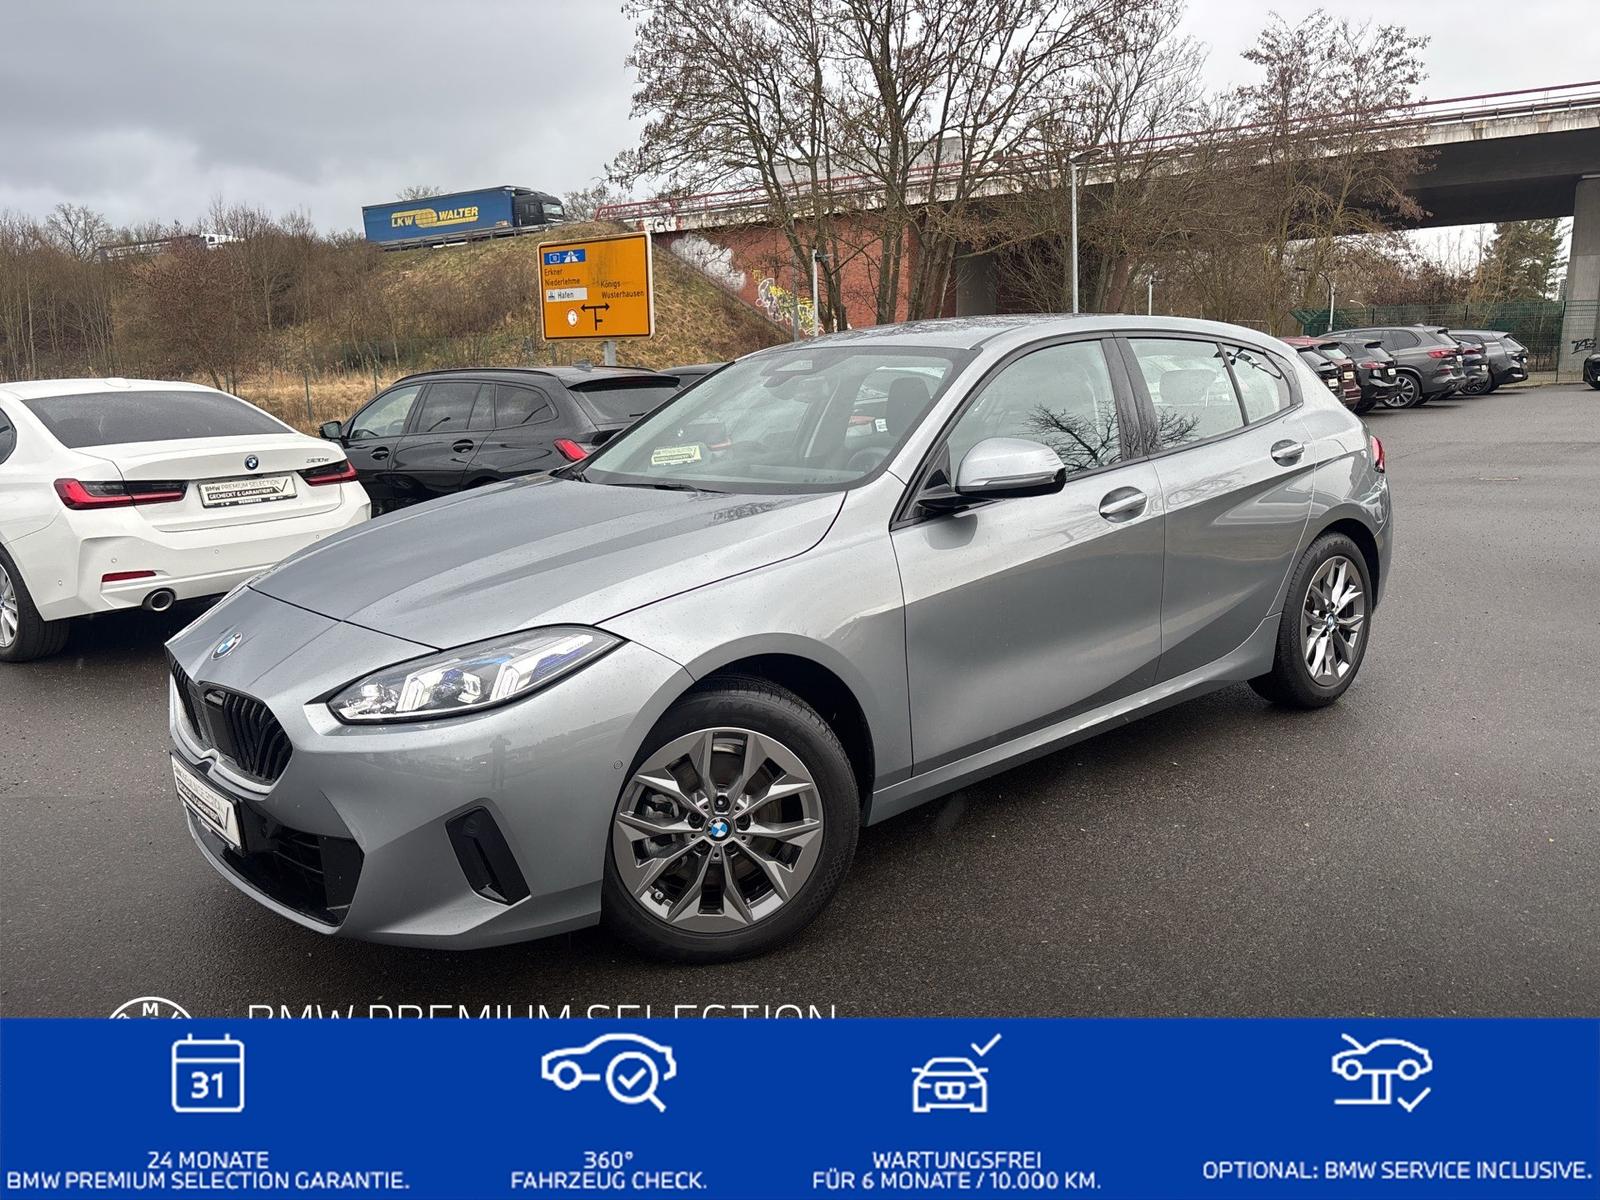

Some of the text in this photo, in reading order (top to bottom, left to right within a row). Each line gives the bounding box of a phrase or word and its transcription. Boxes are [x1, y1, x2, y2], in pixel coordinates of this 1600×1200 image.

[392, 206, 479, 228] LKW WALTER
[544, 268, 563, 277] Erkner
[544, 278, 581, 287] Niederlehme
[600, 280, 621, 289] Königs
[557, 291, 575, 299] Hafen
[601, 290, 645, 299] Wusterhausen
[205, 479, 281, 493] BMW PREMIUM SELECTION
[208, 491, 237, 500] GECHECKT
[242, 488, 274, 496] GARANTIERT
